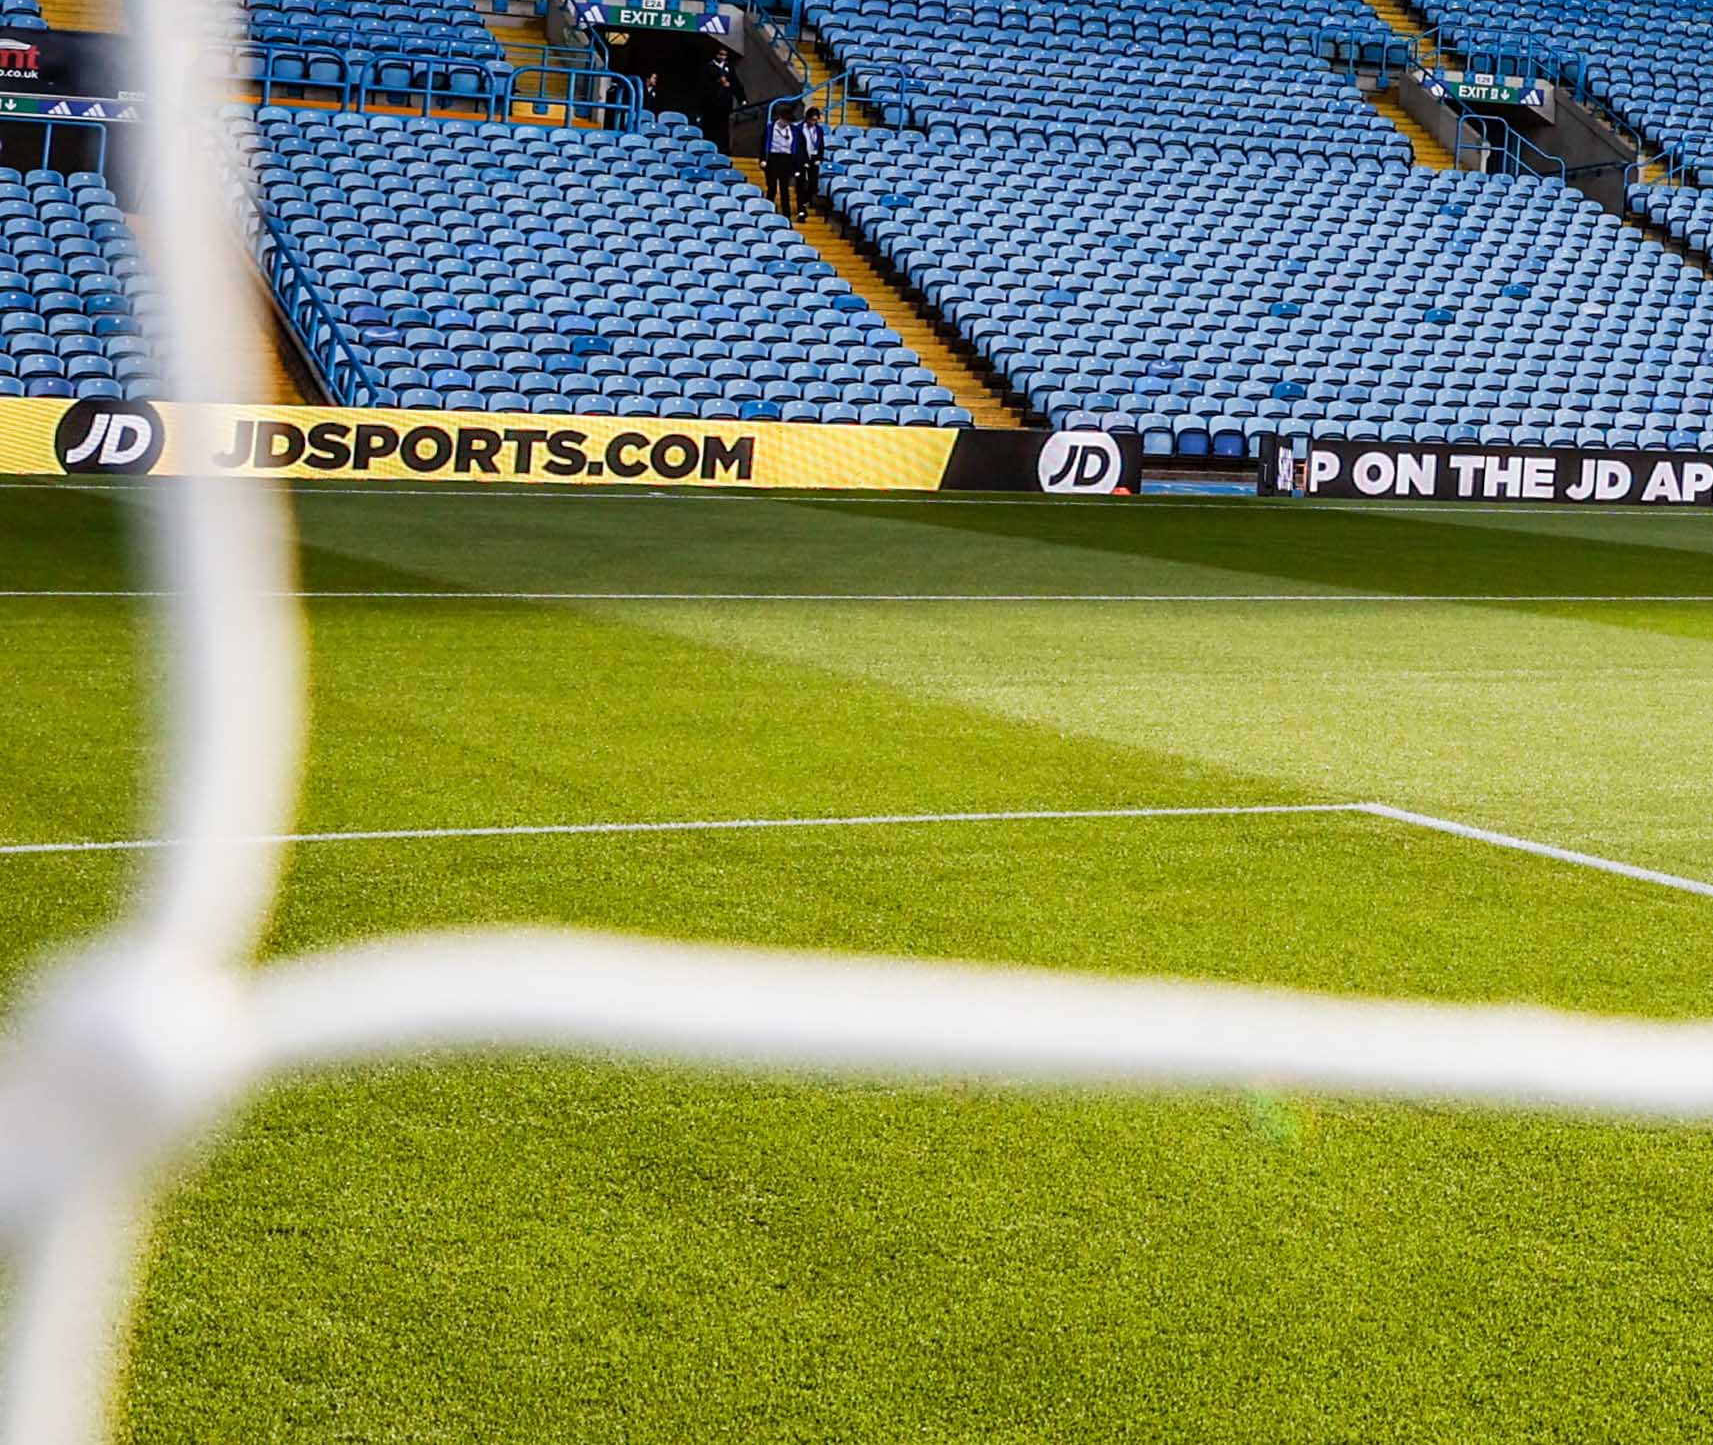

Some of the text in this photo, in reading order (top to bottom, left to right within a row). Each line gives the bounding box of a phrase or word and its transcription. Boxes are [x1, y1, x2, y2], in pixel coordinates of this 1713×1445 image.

[620, 10, 658, 25] EXIT
[1458, 85, 1489, 99] EXIT
[67, 414, 754, 481] JD JDSPORTS.COM
[1049, 444, 1112, 485] JD
[1356, 454, 1435, 497] ON
[1450, 457, 1555, 499] THE
[1567, 458, 1632, 501] JD
